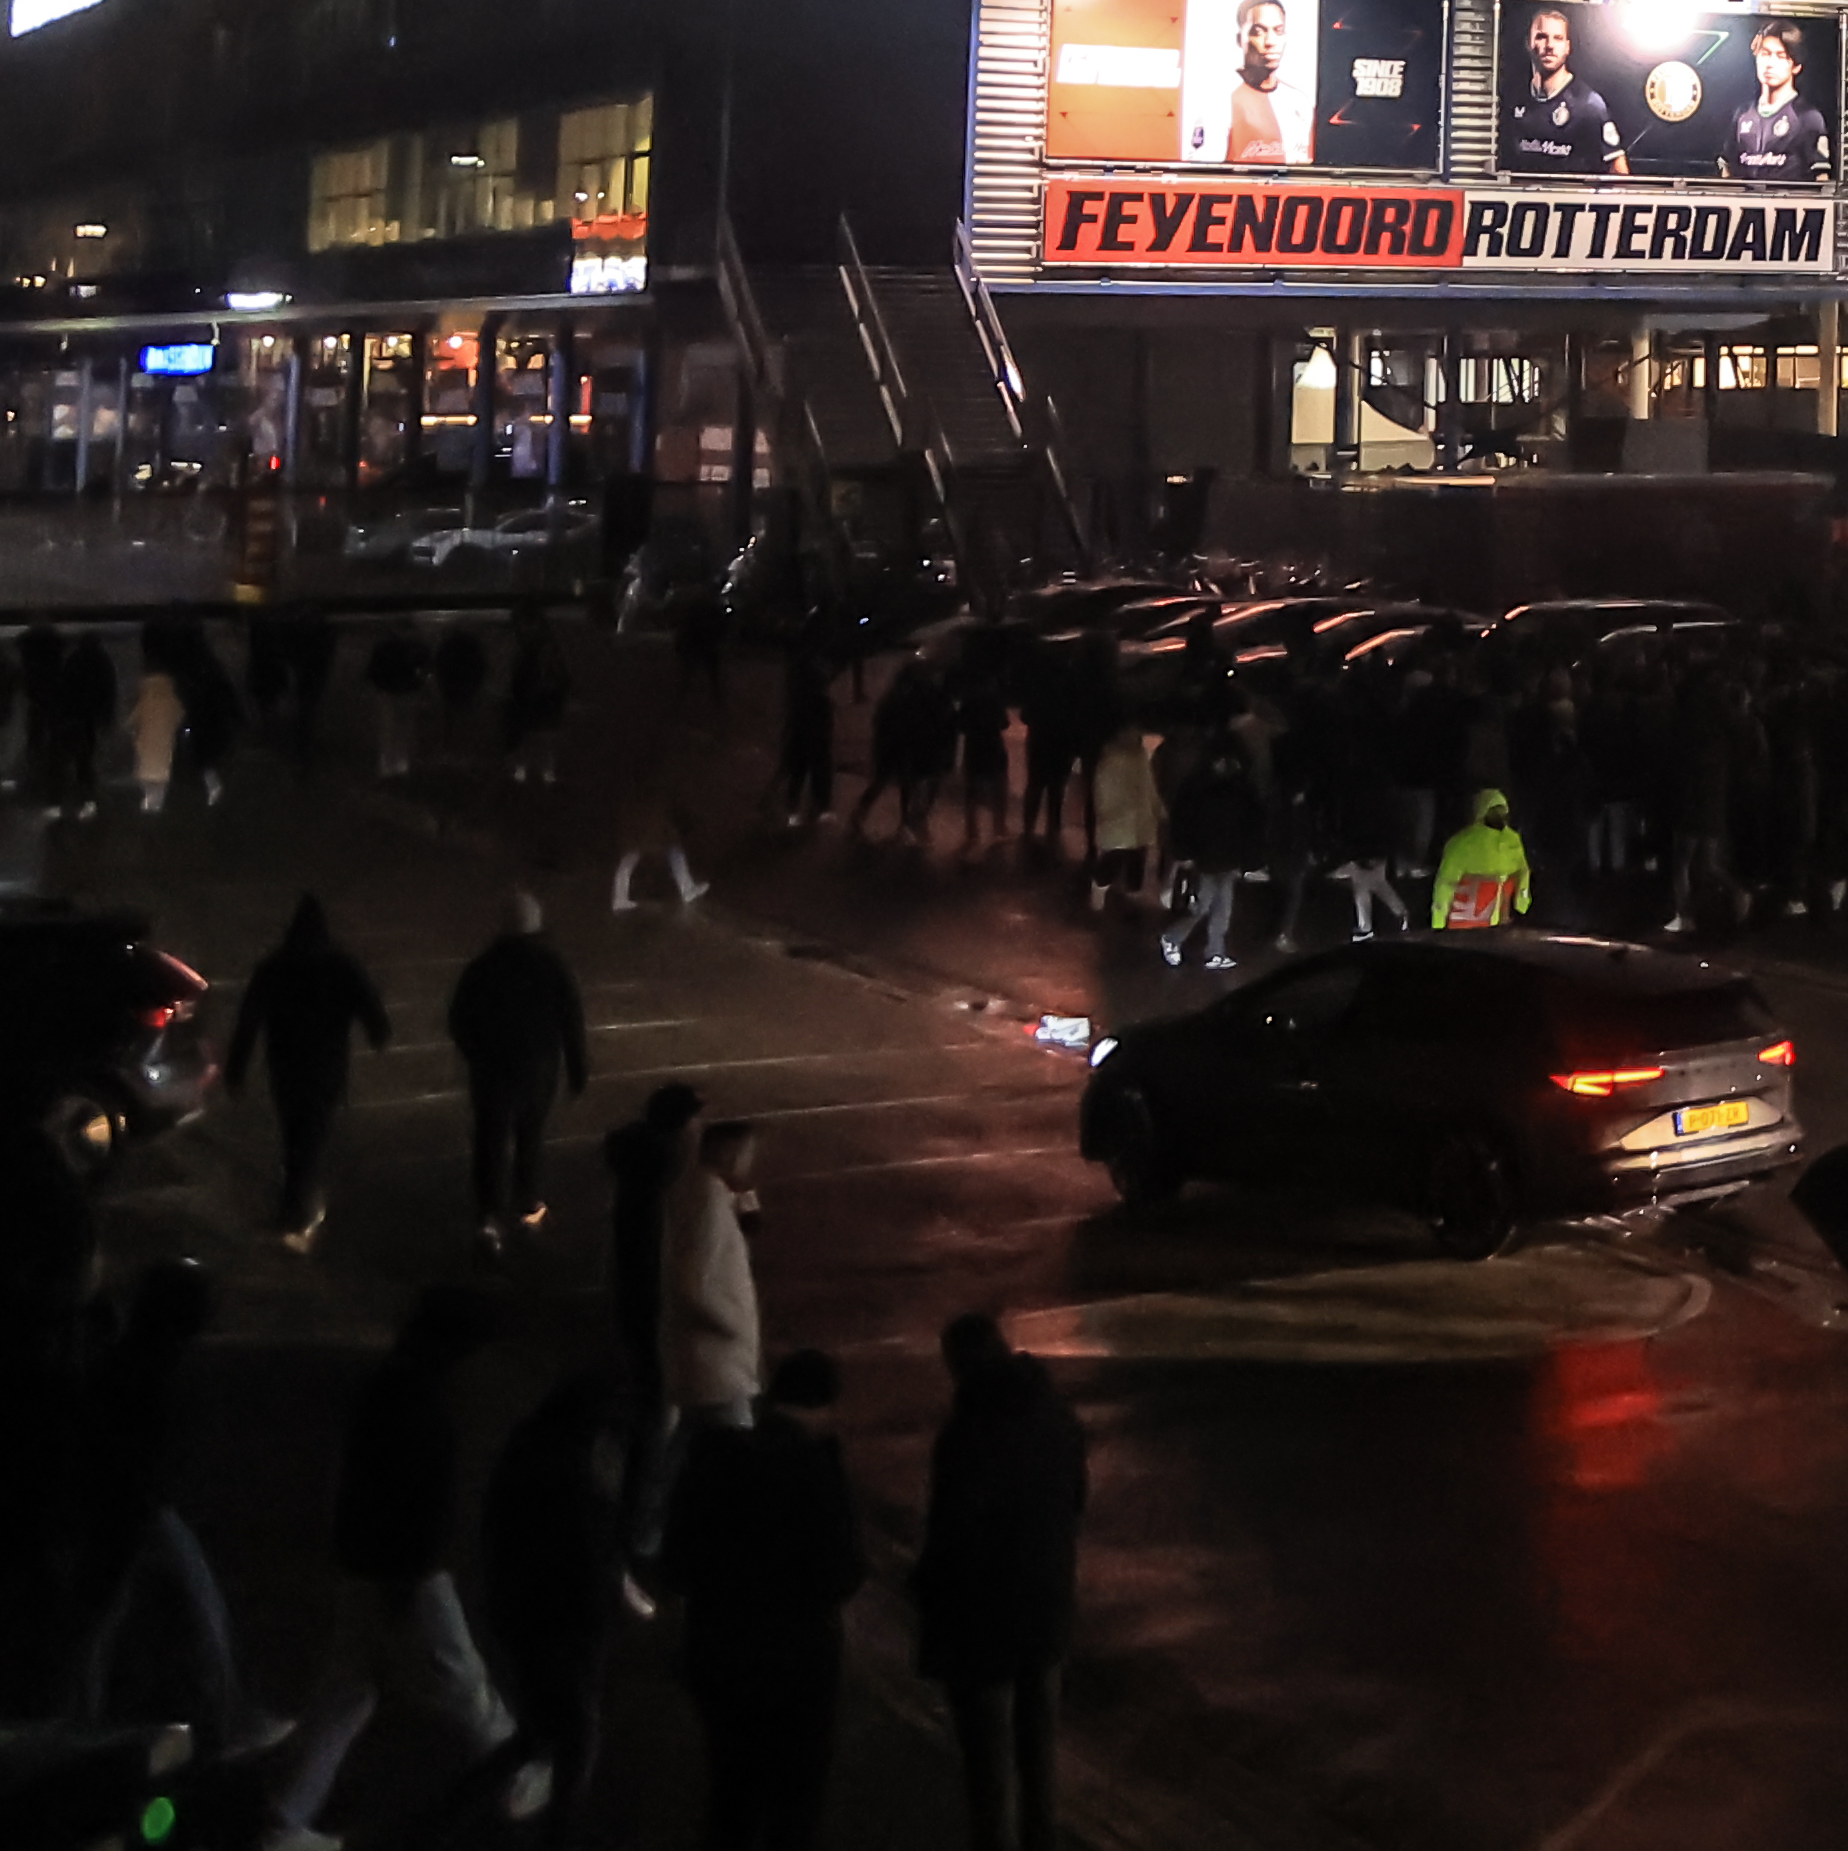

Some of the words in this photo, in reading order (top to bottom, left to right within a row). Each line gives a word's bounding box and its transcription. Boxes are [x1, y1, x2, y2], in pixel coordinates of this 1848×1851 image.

[1352, 58, 1406, 78] SINCE
[1356, 77, 1402, 97] 1908
[1056, 191, 1454, 256] FEYENOORD
[1463, 201, 1826, 261] ROTTERDAM
